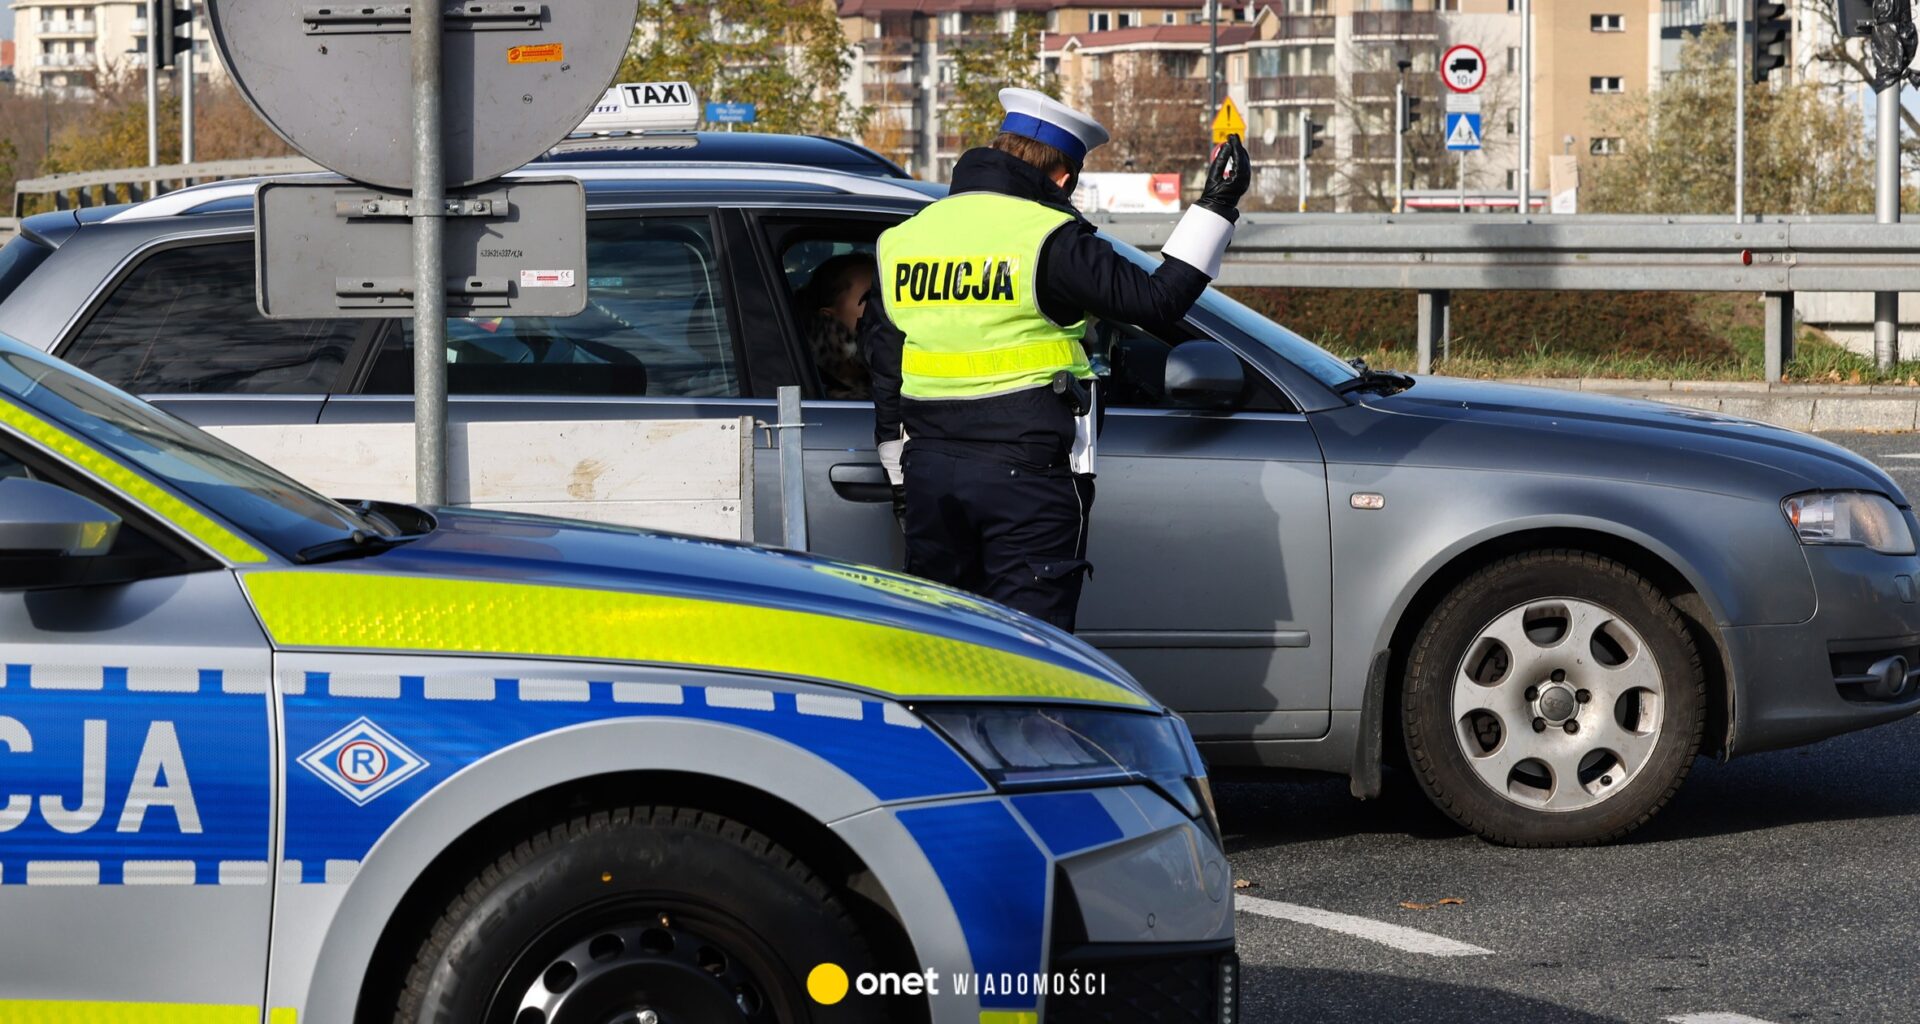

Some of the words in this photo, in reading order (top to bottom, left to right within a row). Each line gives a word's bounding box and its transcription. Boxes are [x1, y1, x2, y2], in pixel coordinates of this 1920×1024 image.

[625, 84, 688, 104] TAXI
[895, 261, 1014, 302] POLICJA
[352, 749, 375, 774] R
